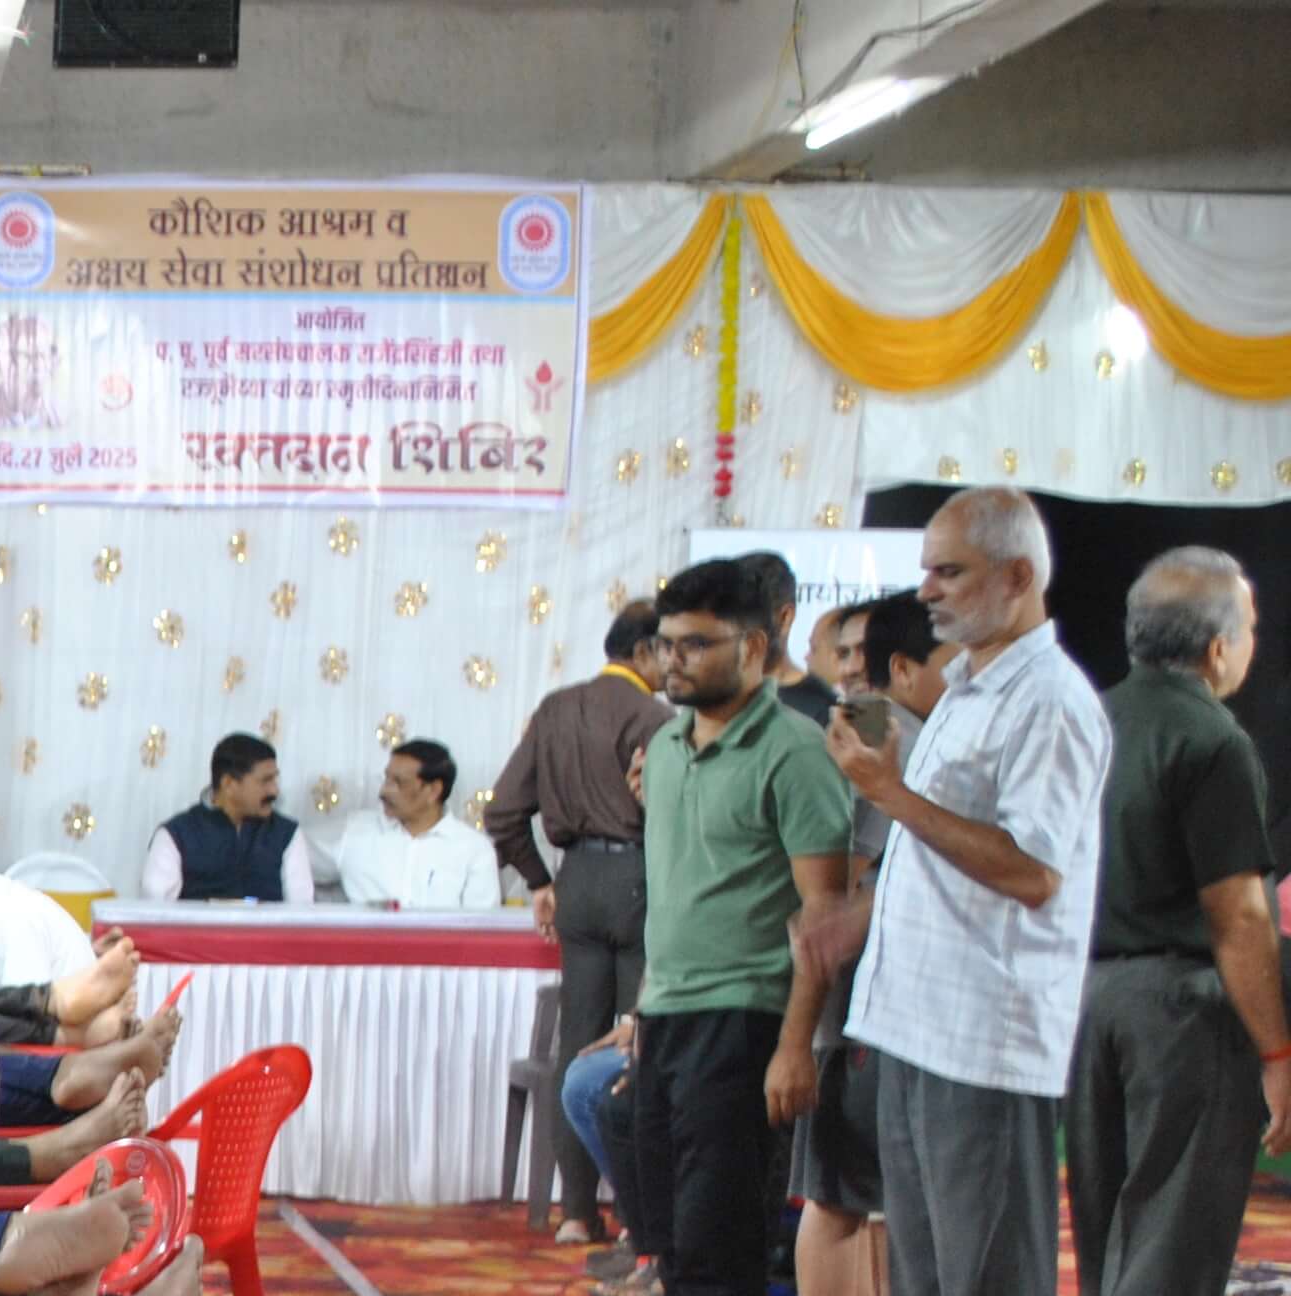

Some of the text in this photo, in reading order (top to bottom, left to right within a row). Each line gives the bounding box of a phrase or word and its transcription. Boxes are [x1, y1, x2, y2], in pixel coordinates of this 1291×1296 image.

[148, 196, 410, 237] कौशिक आश्रम व
[66, 256, 149, 290] अक्षय
[160, 247, 226, 289] सेवा
[234, 247, 364, 289] संशोधन
[297, 306, 365, 331] आयोजित
[89, 446, 137, 468] 2025
[389, 422, 549, 475] शिबिर
